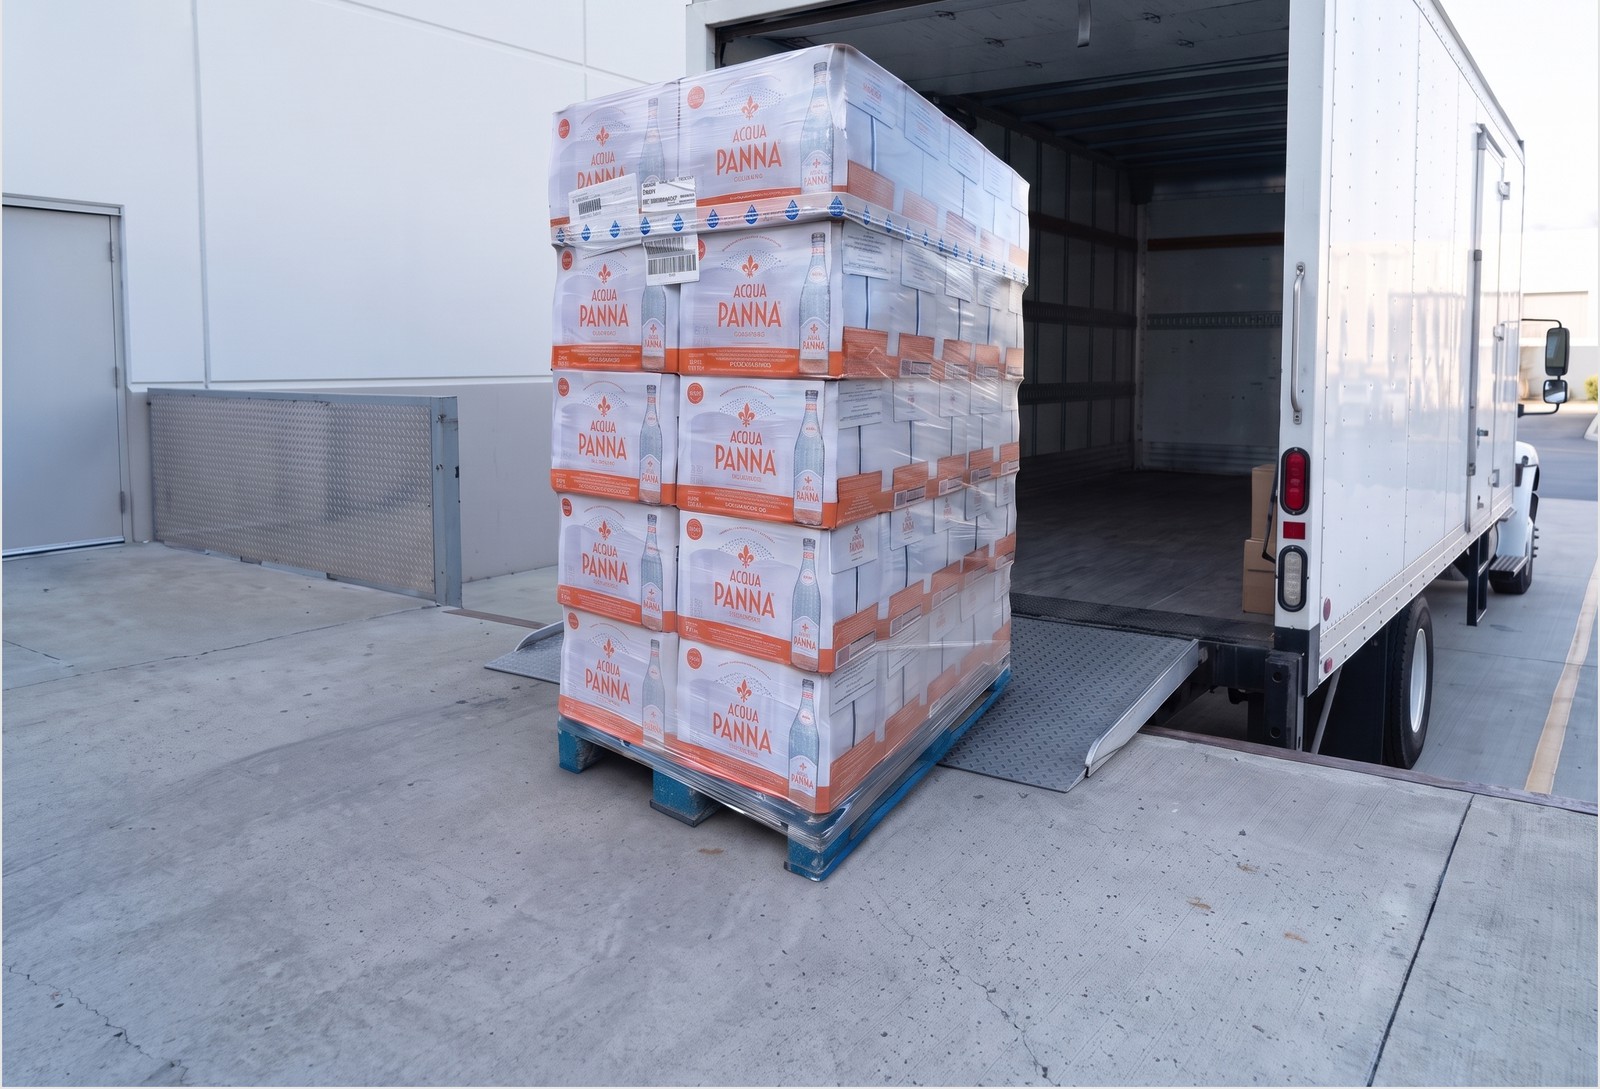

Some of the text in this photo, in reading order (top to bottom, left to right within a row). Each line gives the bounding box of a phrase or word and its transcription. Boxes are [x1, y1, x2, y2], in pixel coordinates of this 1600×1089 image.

[733, 124, 767, 143] ACQUA
[716, 141, 782, 176] PANNA
[591, 289, 618, 303] ACQUA
[733, 284, 767, 298] ACQUA
[579, 304, 630, 328] PANNA
[717, 301, 782, 327] PANNA
[590, 420, 616, 434] ACQUA
[729, 430, 763, 445] ACQUA
[578, 433, 627, 460] PANNA
[714, 445, 777, 476] PANNA
[592, 542, 618, 557] ACQUA
[581, 553, 629, 585] PANNA
[729, 569, 762, 587] ACQUA
[713, 582, 775, 618] PANNA
[585, 668, 631, 704] PANNA
[713, 713, 772, 754] PANNA
